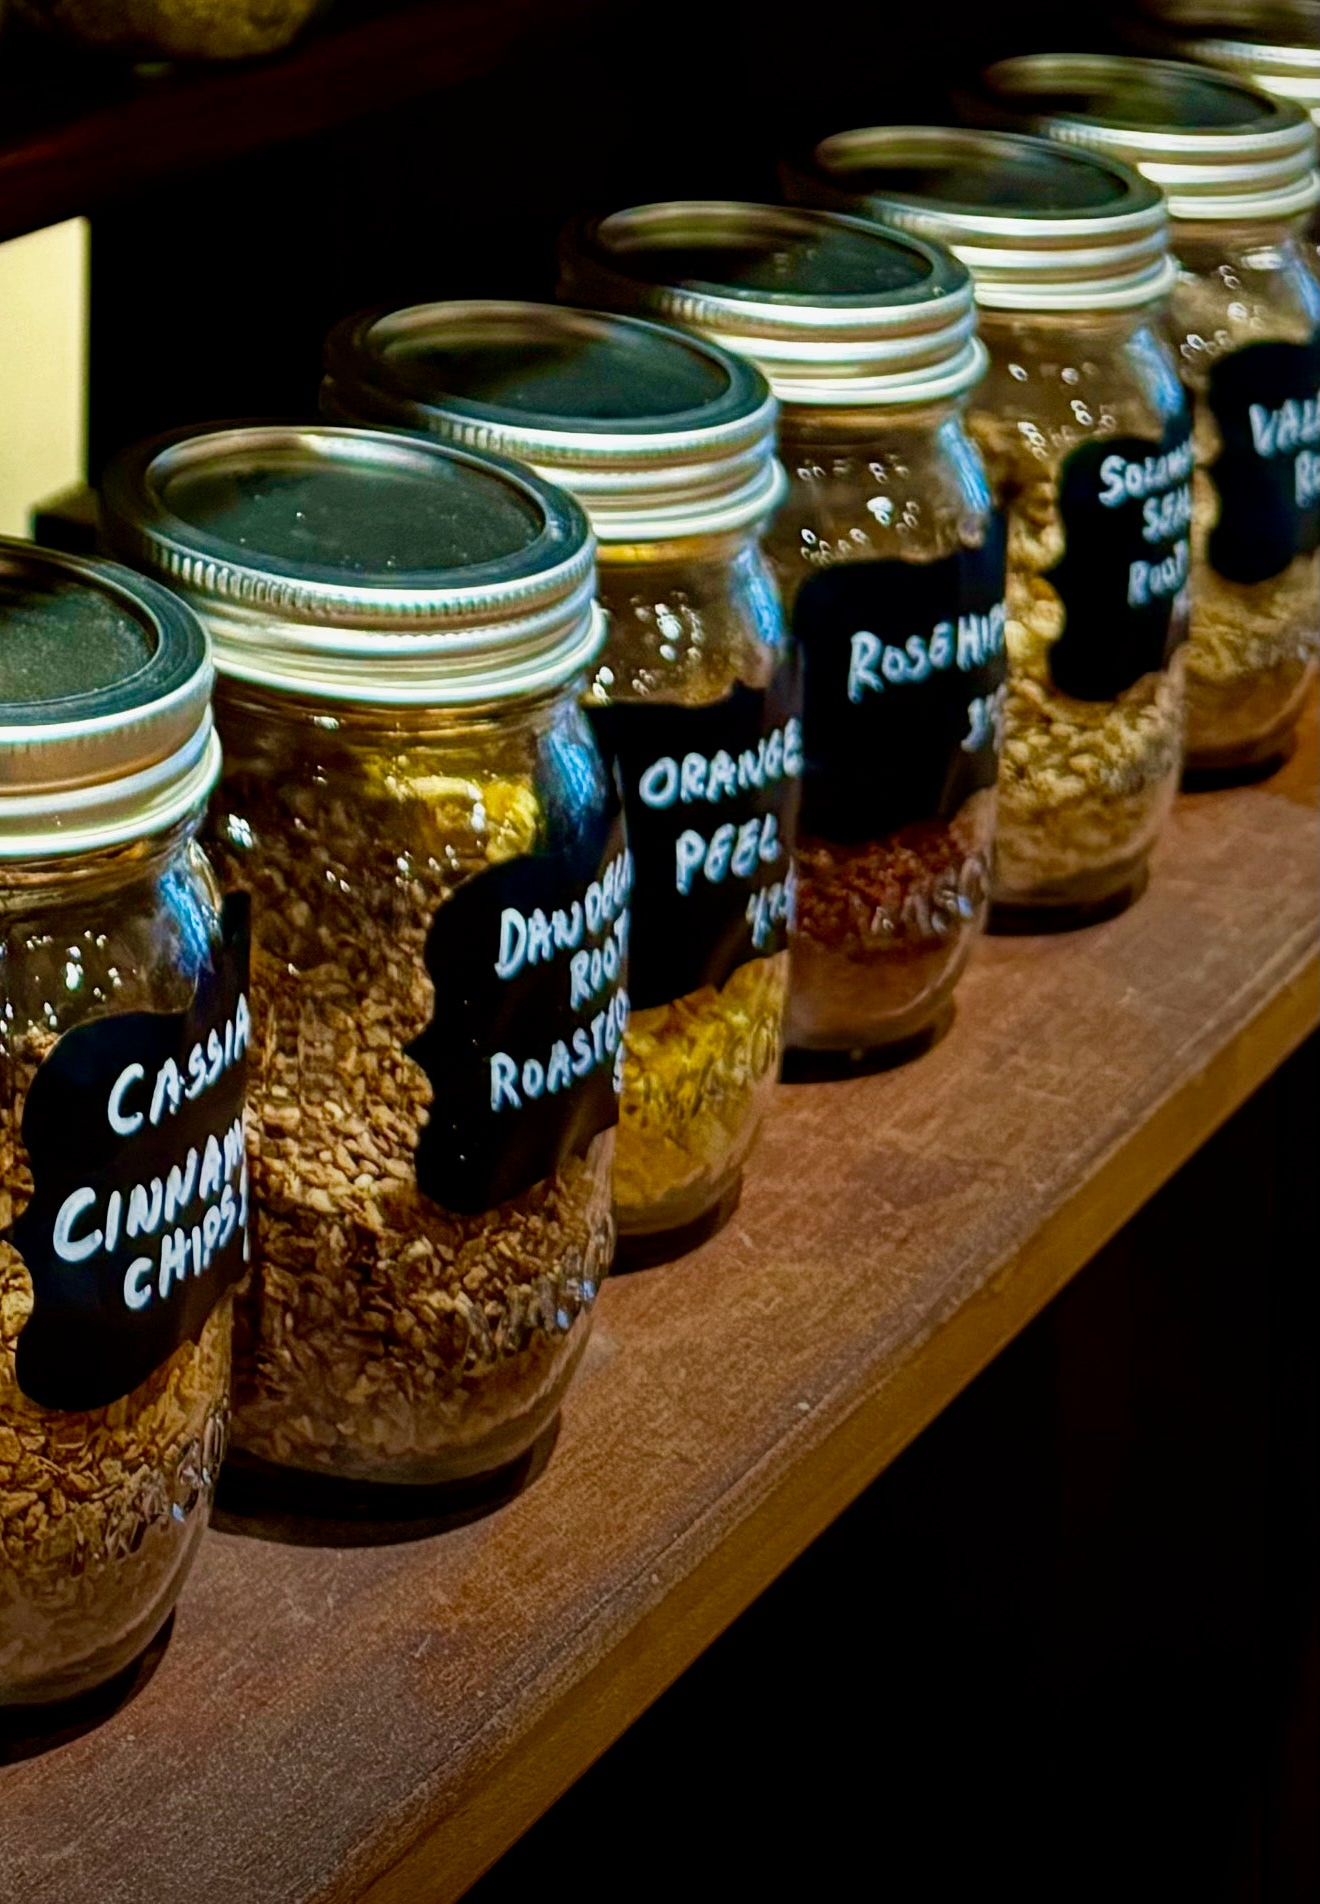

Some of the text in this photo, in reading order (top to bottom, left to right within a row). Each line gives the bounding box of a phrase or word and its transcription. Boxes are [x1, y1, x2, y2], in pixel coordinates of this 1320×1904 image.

[639, 717, 804, 809] ORANGE
[676, 813, 781, 895] PEEL
[570, 908, 630, 1012] ROOT
[107, 992, 251, 1136] CASSIA
[123, 1183, 237, 1311] CHIPS
